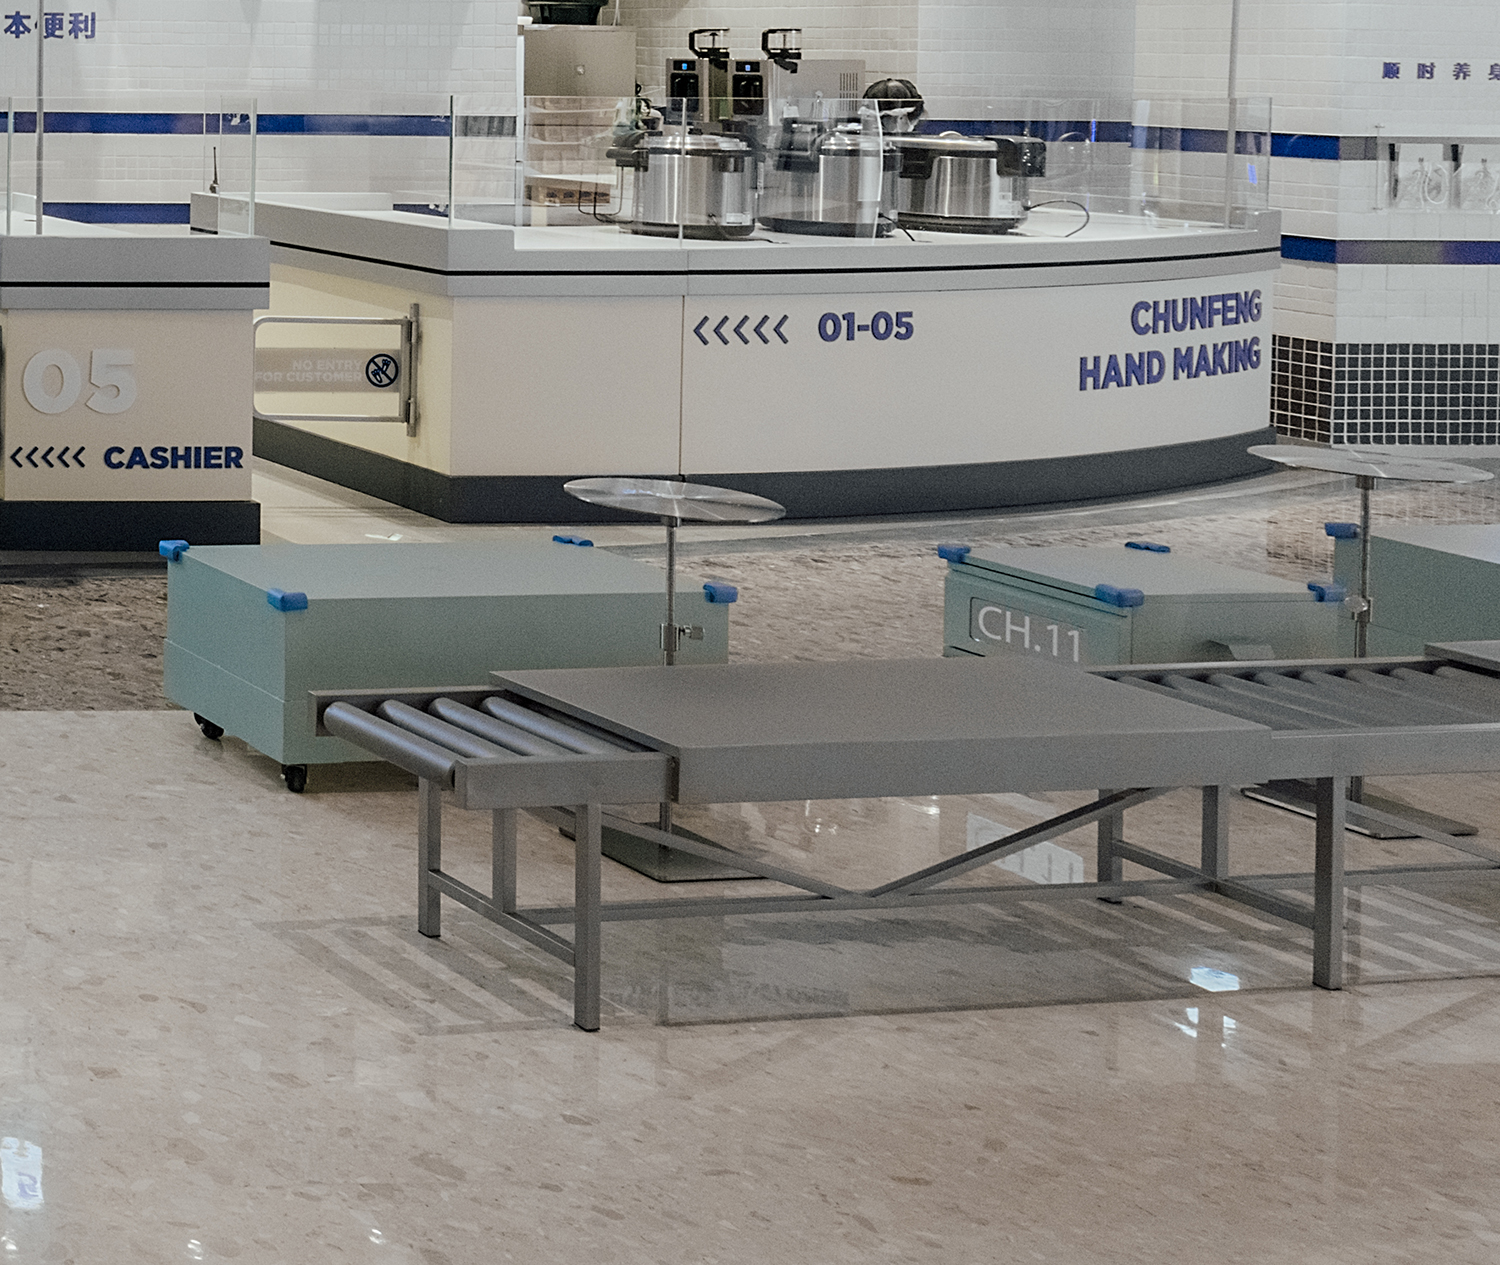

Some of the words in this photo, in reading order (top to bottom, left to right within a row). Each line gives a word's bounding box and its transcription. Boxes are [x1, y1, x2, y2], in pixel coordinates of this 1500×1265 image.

[817, 311, 914, 342] 01-05
[1130, 289, 1262, 336] CHUNFENG
[22, 347, 139, 414] 05
[255, 372, 283, 382] FOR
[287, 371, 362, 382] CUSTOMER
[293, 360, 313, 370] NO
[317, 360, 361, 370] ENTRY
[1079, 350, 1166, 392] HAND
[1173, 335, 1261, 381] MAKING
[103, 446, 244, 470] CASHIER
[978, 606, 1079, 662] CH.11
